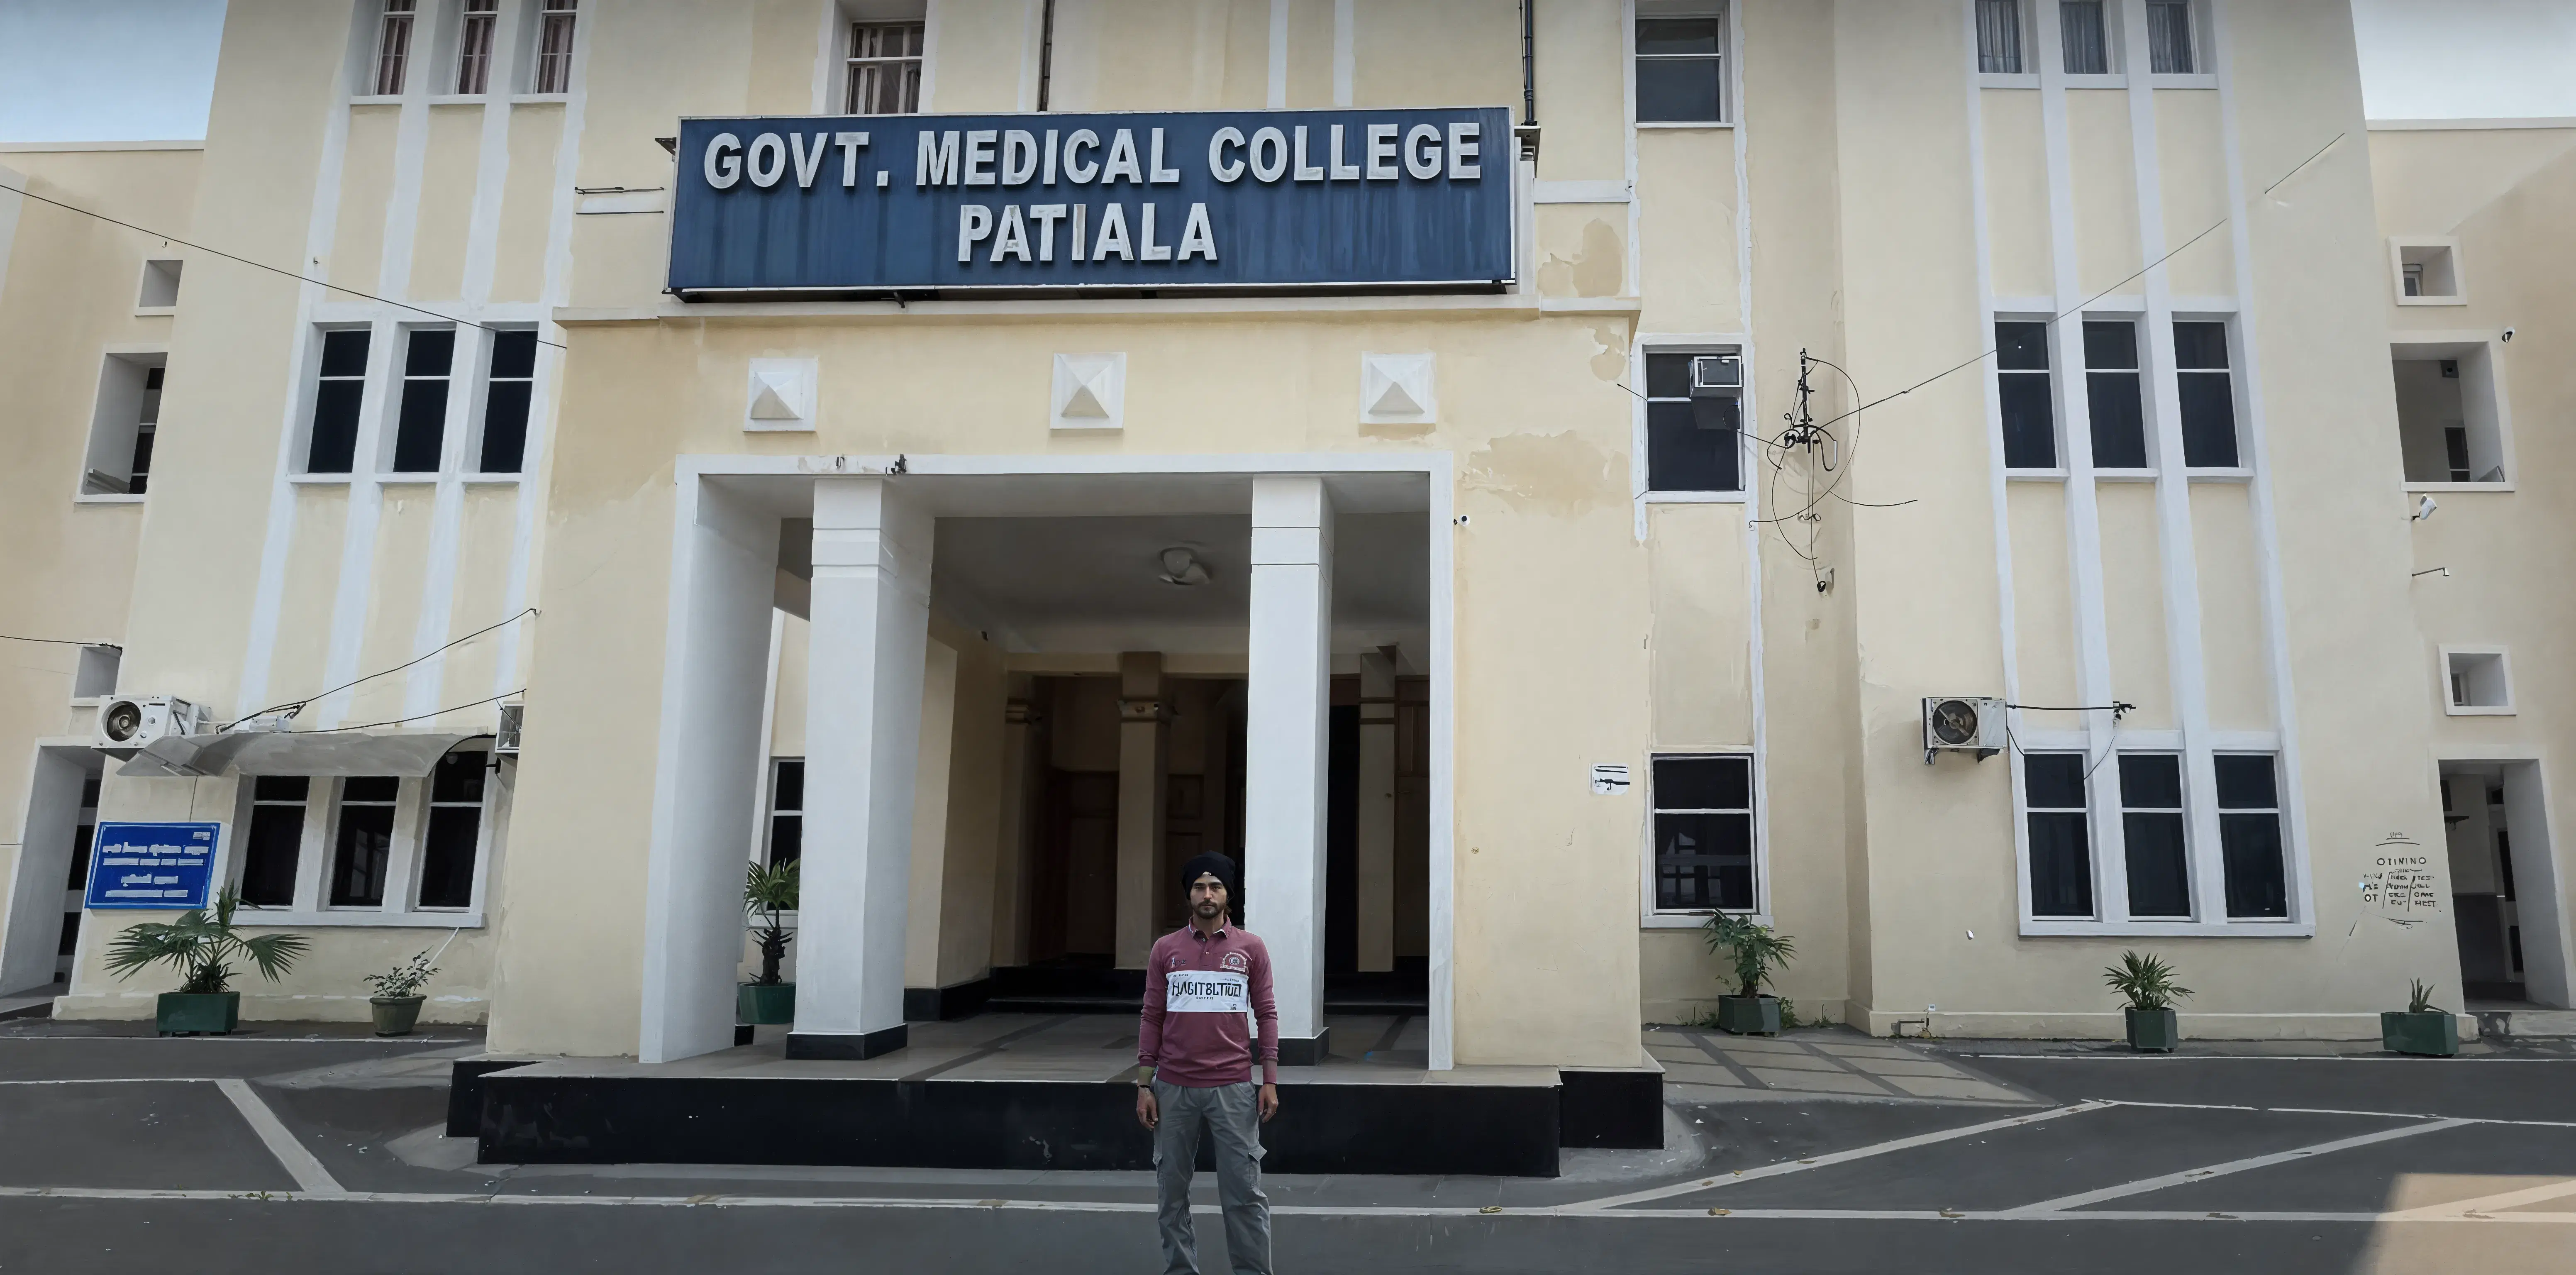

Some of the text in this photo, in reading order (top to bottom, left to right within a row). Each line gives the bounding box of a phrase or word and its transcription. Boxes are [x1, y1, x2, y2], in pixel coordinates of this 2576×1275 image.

[704, 122, 1481, 189] GOVT. MEDICAL COLLEGE
[958, 203, 1217, 261] PATIALA
